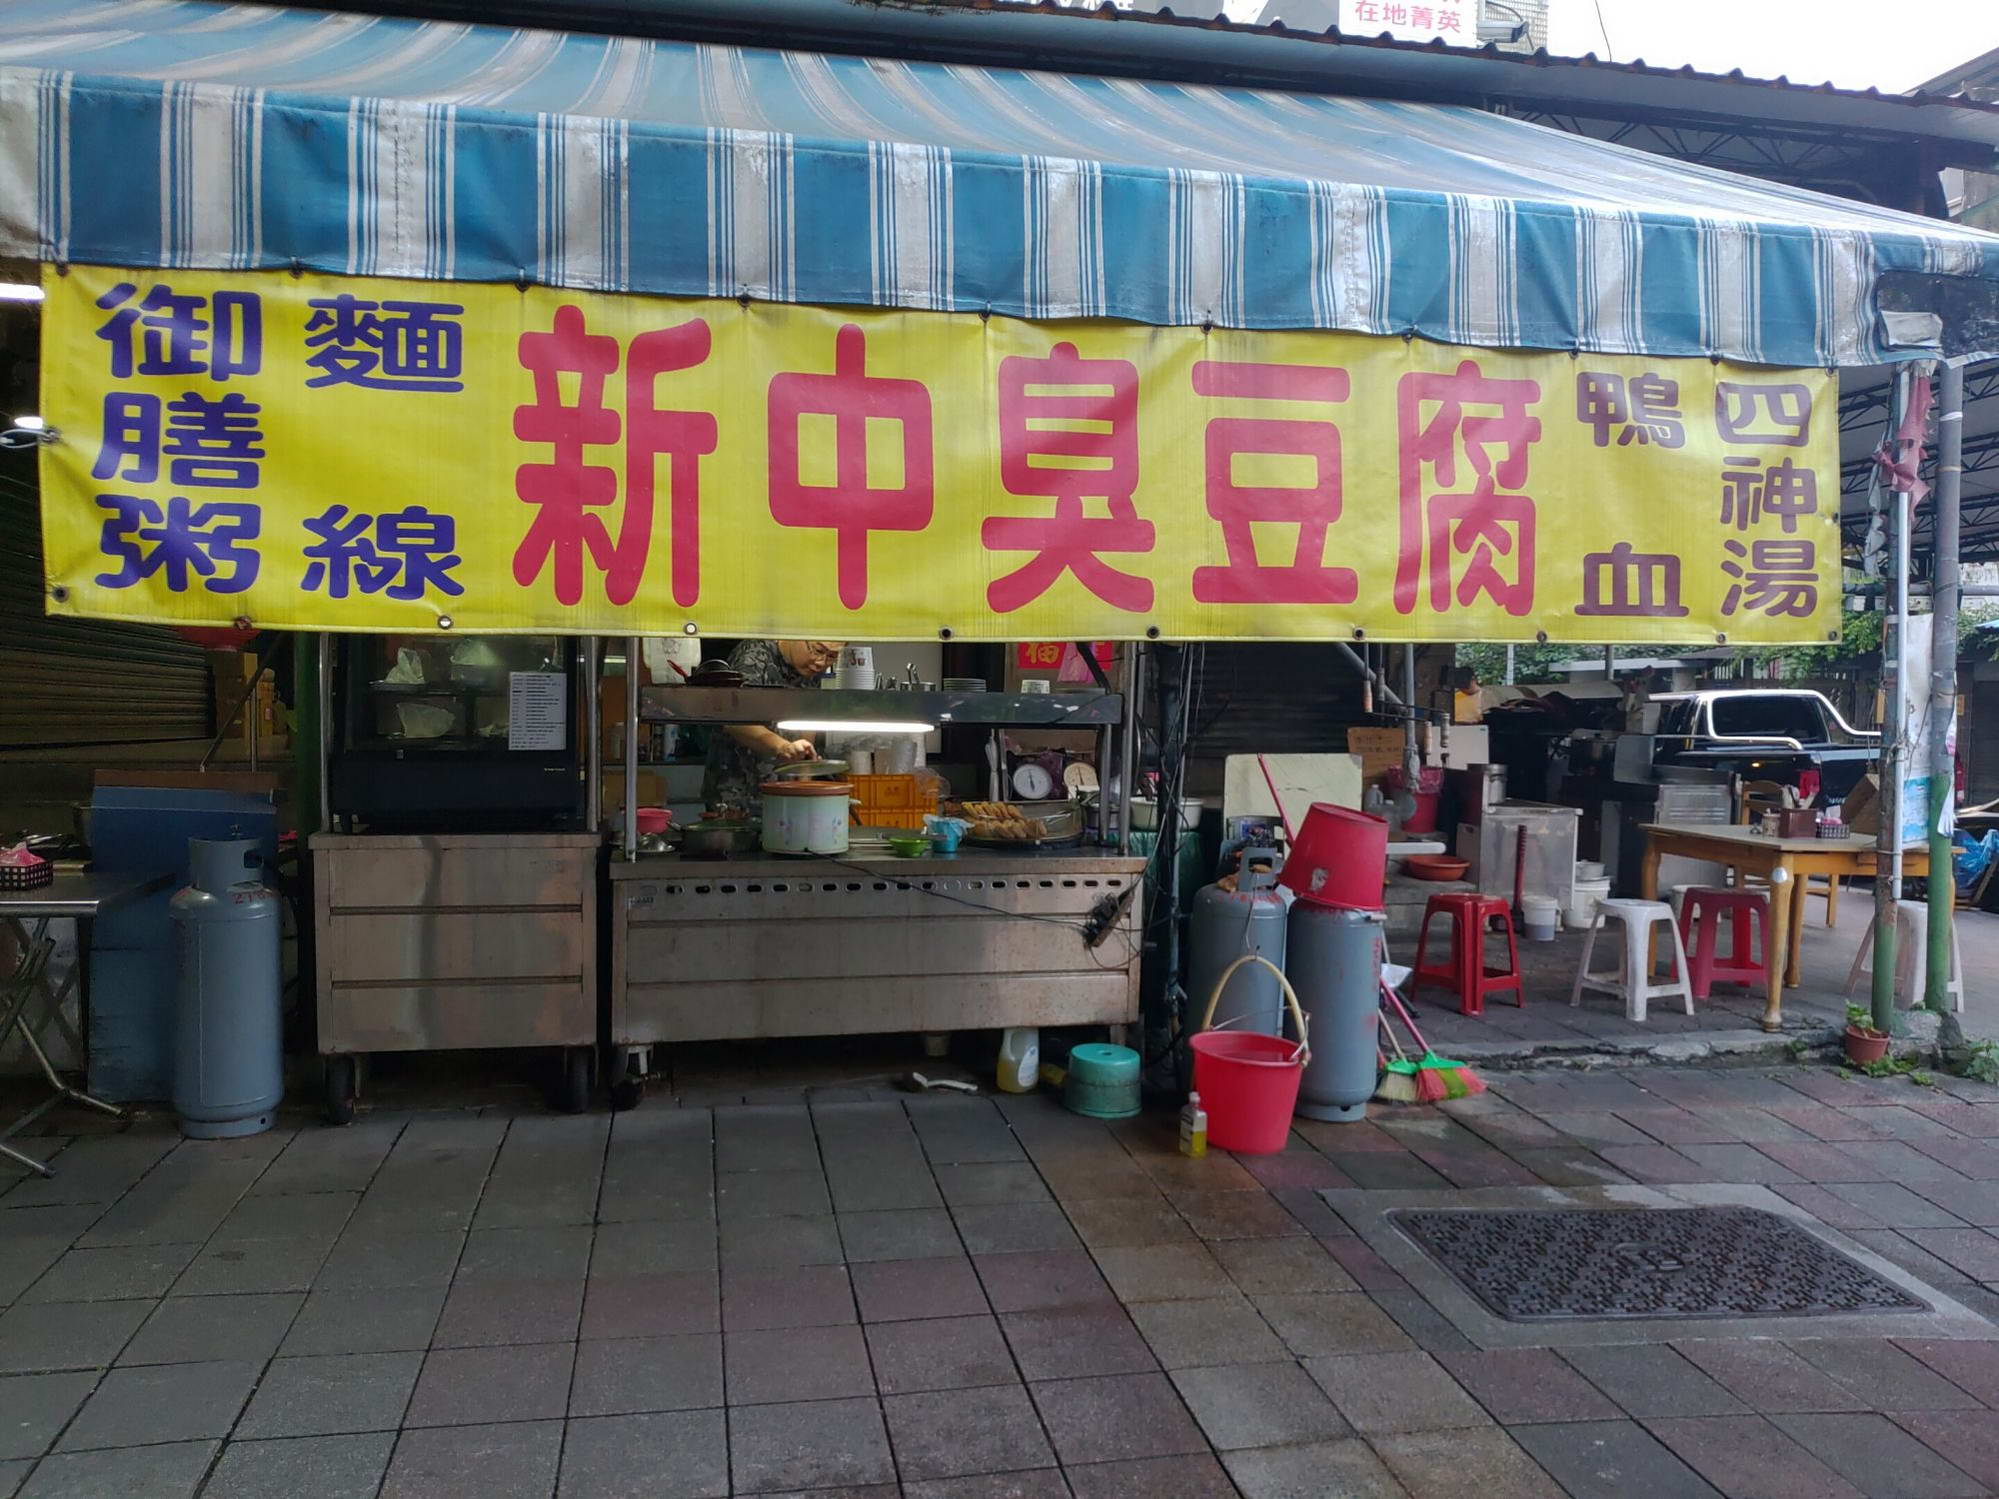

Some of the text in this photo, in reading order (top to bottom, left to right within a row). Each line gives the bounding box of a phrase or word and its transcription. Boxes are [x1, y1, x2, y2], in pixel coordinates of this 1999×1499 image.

[92, 283, 266, 594] 御膳粥
[301, 294, 465, 601] 麵線
[512, 304, 1542, 617] 新中臭豆腐
[1574, 371, 1690, 618] 鴨血
[1715, 381, 1819, 618] 四神湯
